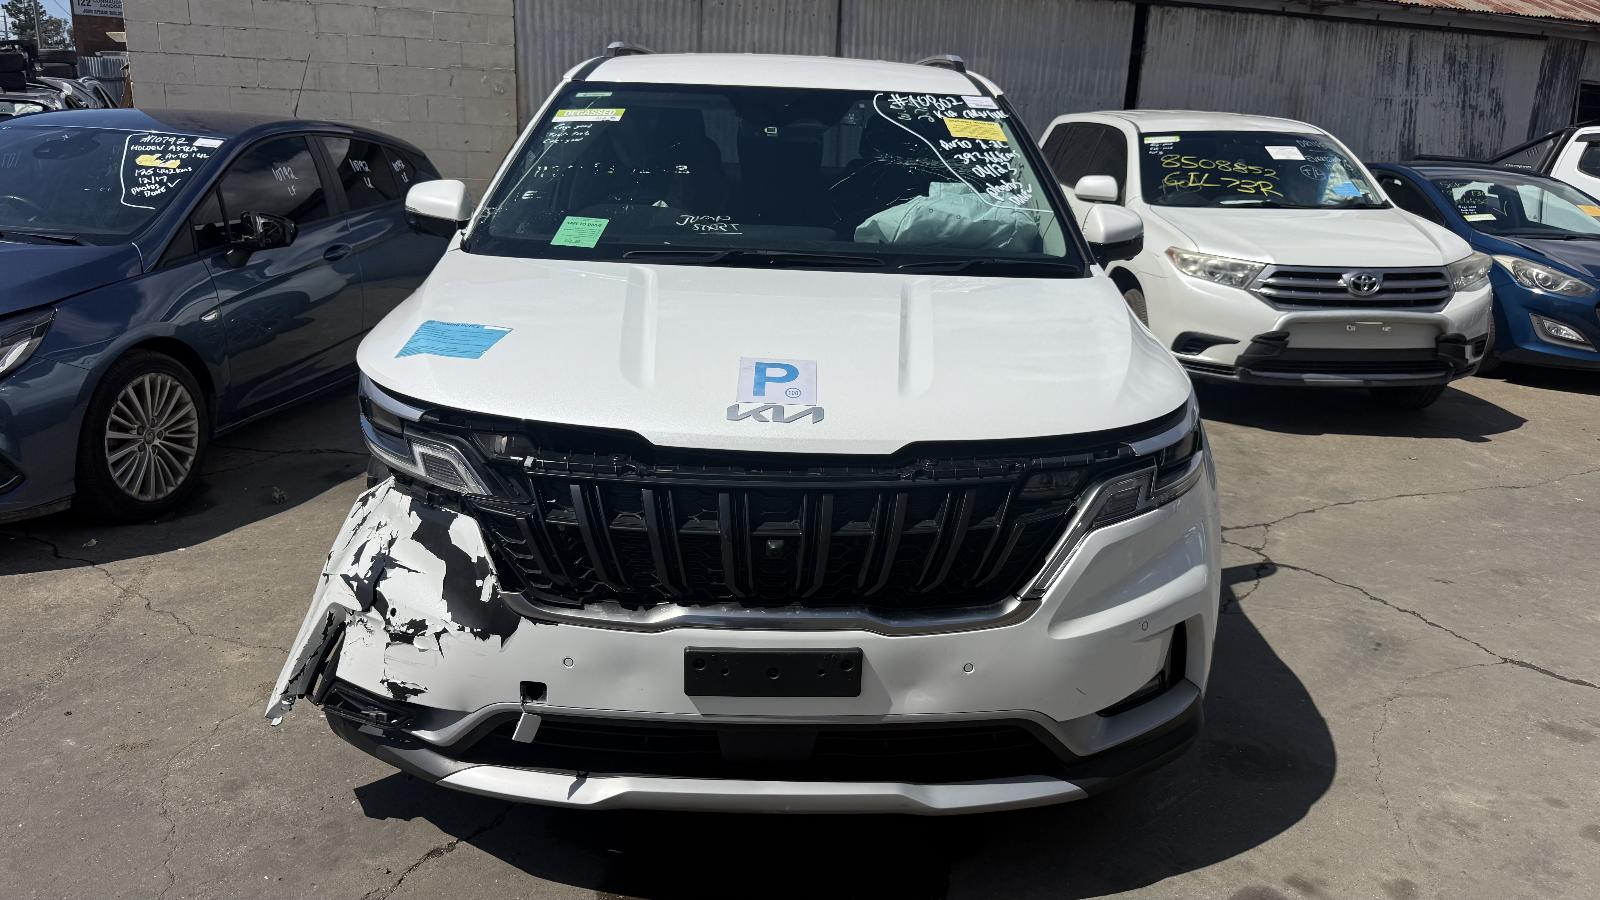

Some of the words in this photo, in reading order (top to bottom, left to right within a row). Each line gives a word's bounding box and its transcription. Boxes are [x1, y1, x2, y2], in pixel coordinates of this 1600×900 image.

[933, 110, 958, 119] KIA
[1160, 154, 1280, 180] 8508852
[693, 222, 740, 231] START
[753, 361, 800, 397] P
[726, 403, 825, 424] KIA
